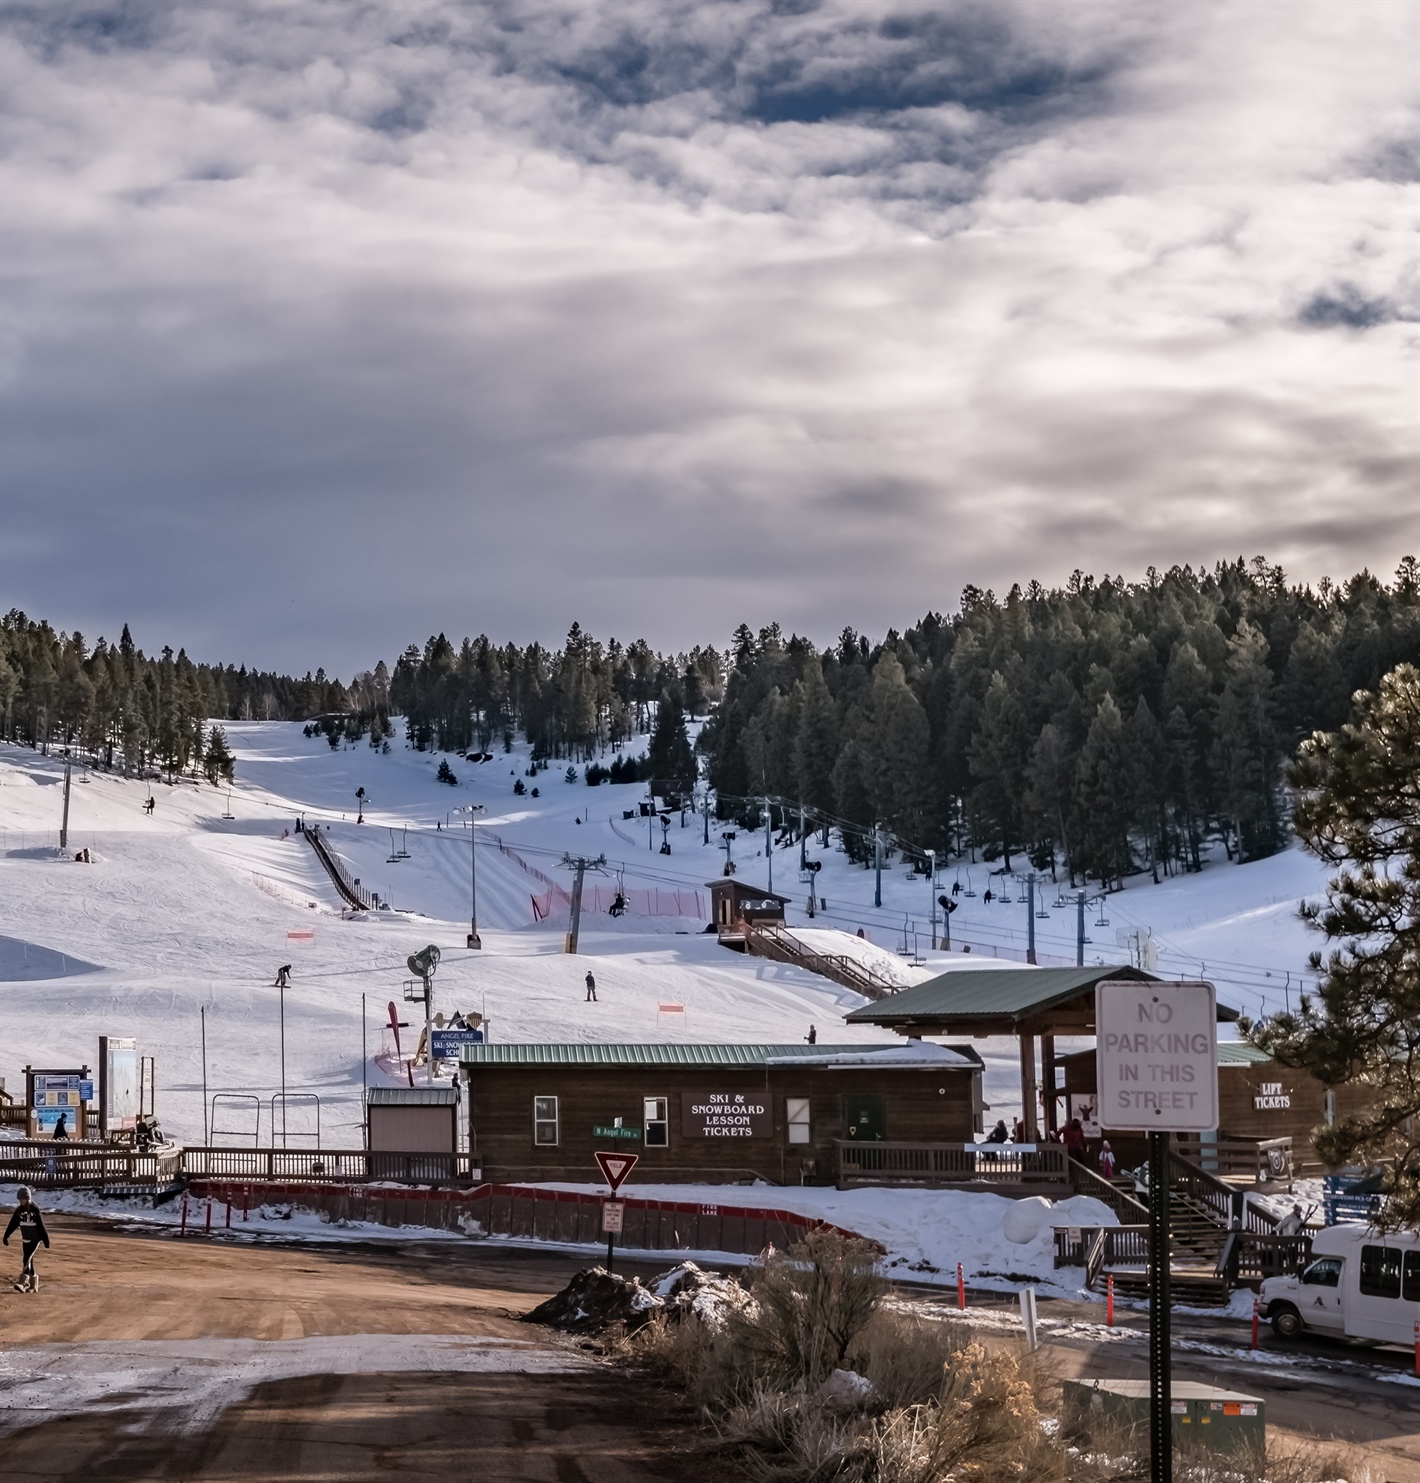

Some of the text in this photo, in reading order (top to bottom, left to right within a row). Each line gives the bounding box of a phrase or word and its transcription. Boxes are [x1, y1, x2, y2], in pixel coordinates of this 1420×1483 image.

[1137, 1002, 1173, 1024] NO
[1105, 1033, 1209, 1055] PARKING
[1119, 1064, 1195, 1082] IN THIS
[1261, 1083, 1282, 1095] LIFT
[709, 1094, 744, 1103] SKI &
[1117, 1090, 1198, 1109] STREET
[1254, 1096, 1291, 1109] TICKETS
[691, 1105, 765, 1114] SNOWBOARD
[706, 1116, 750, 1125] LESSON
[603, 1128, 619, 1137] Angel
[620, 1129, 631, 1137] Fire
[702, 1127, 753, 1136] TICKETS
